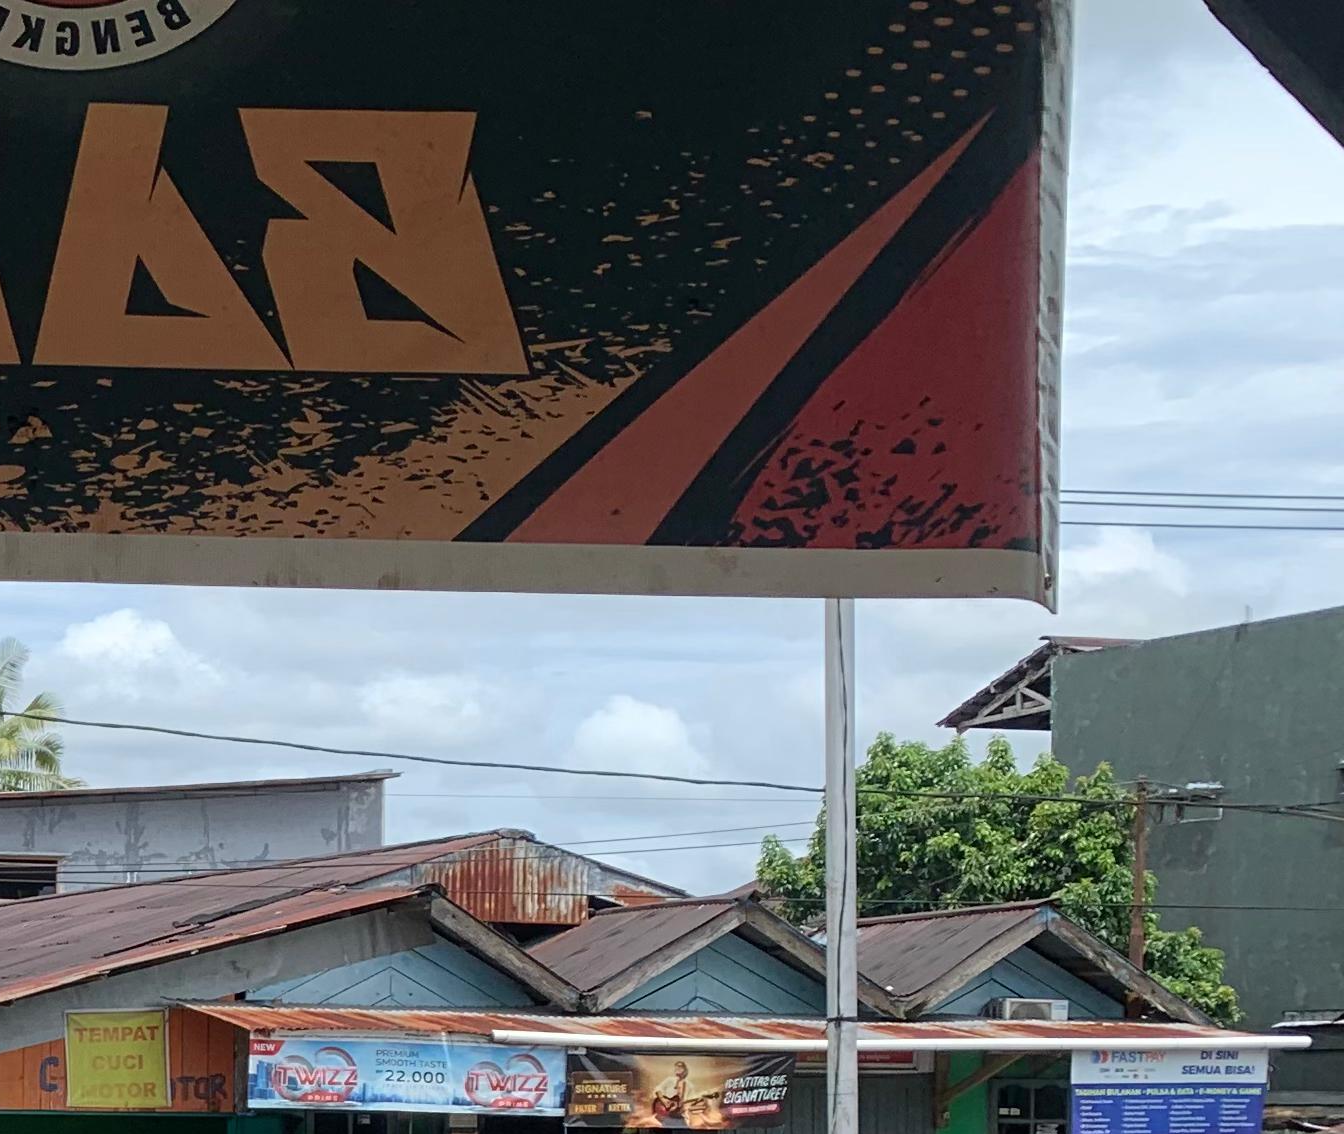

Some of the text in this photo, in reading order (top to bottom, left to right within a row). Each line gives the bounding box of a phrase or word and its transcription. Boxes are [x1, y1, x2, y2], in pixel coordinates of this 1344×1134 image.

[74, 1026, 159, 1043] TEMPAT
[254, 1043, 275, 1051] NEW
[376, 1049, 419, 1058] PREMIUM
[1200, 1050, 1239, 1060] DI SINI
[92, 1054, 143, 1070] CUCI
[375, 1058, 448, 1069] SMOOTH TASTE
[276, 1066, 358, 1085] TWIZZ
[1182, 1064, 1256, 1075] SEMUA BISA!
[468, 1072, 548, 1092] TWIZZ
[575, 1083, 628, 1094] SIGNATURE
[80, 1082, 157, 1099] MOTOR
[723, 1086, 788, 1103] SIGNATURE!
